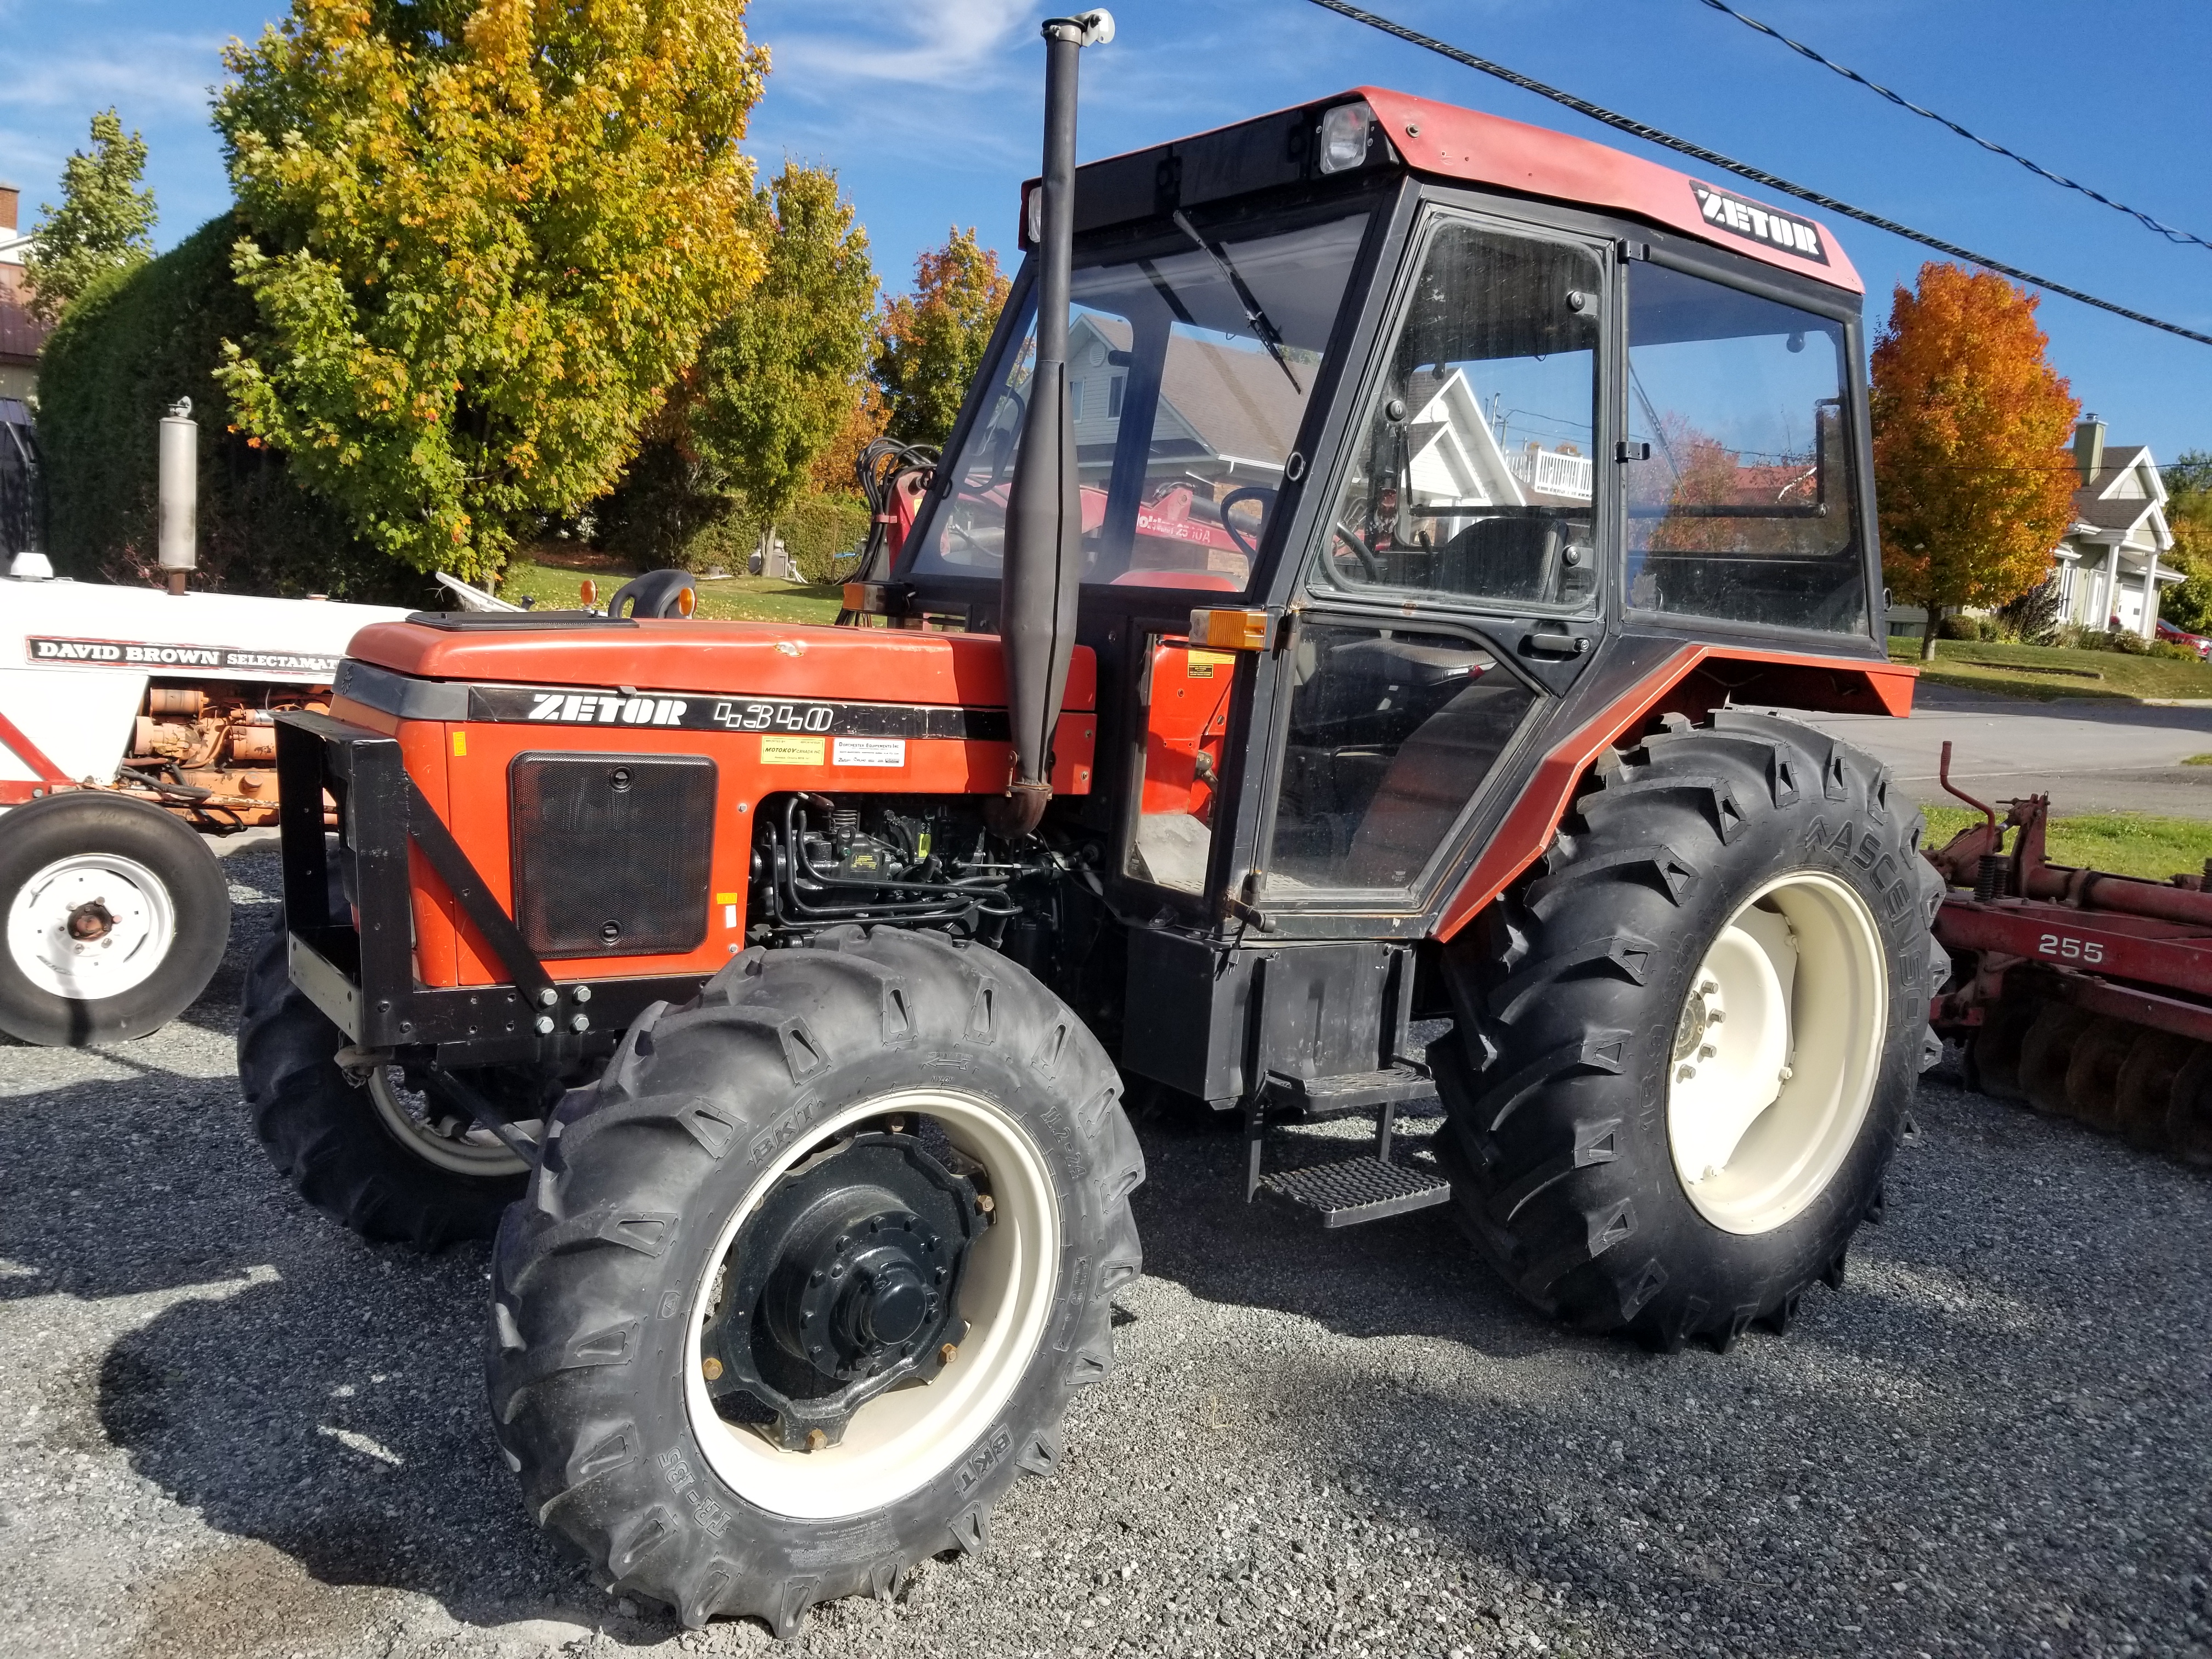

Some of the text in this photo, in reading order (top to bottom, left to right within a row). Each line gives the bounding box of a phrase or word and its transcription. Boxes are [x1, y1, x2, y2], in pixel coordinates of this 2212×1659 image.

[1698, 189, 1819, 255] ZETOR
[38, 642, 339, 670] DAVID BROWN SELECTAMAT
[528, 694, 834, 732] ZETOR 6340
[1825, 821, 1923, 1028] ASCENSO
[2039, 934, 2104, 964] 255
[752, 1094, 816, 1164] BKT
[1041, 1106, 1086, 1179] 11.2-24
[658, 1447, 732, 1538] TR-135
[959, 1429, 1012, 1496] BKT
